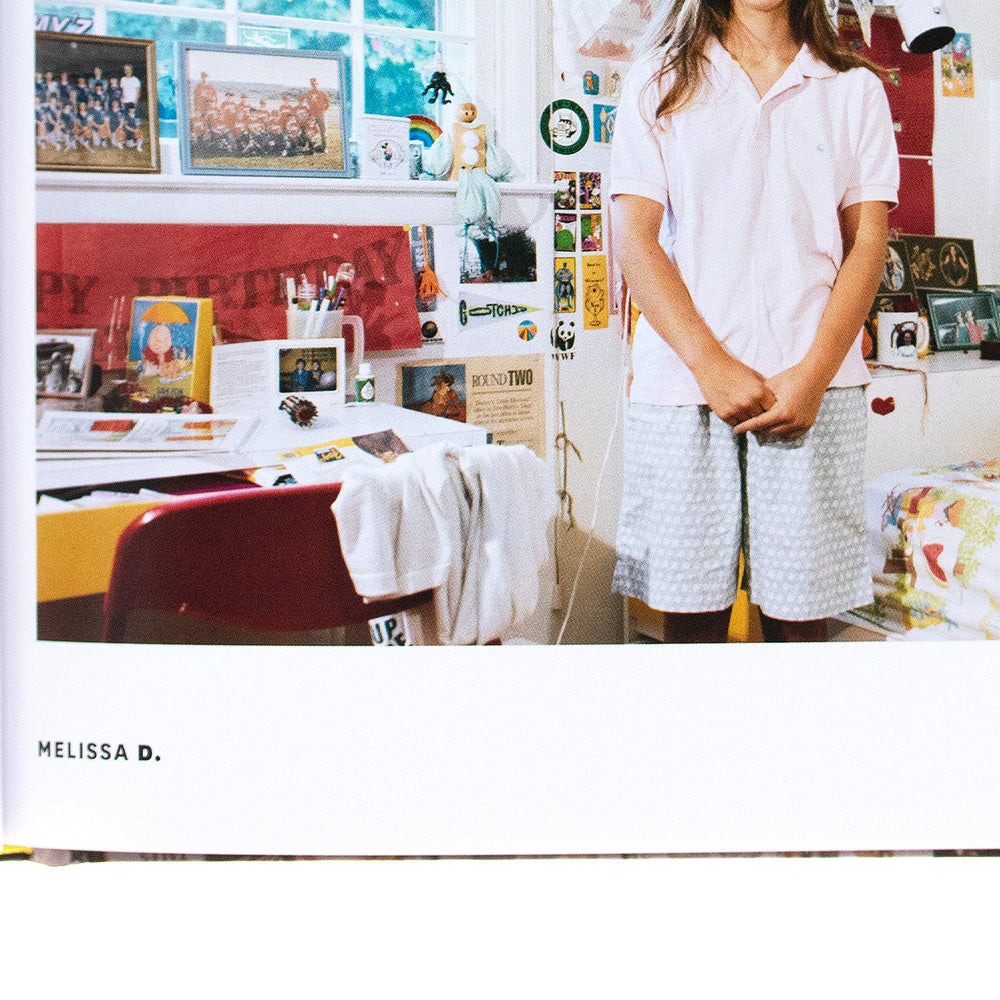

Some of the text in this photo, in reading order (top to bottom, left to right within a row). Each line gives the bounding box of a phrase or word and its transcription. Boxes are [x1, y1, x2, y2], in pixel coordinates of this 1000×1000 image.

[472, 368, 533, 388] ROUND TWO
[38, 740, 161, 762] MELISSA D.
